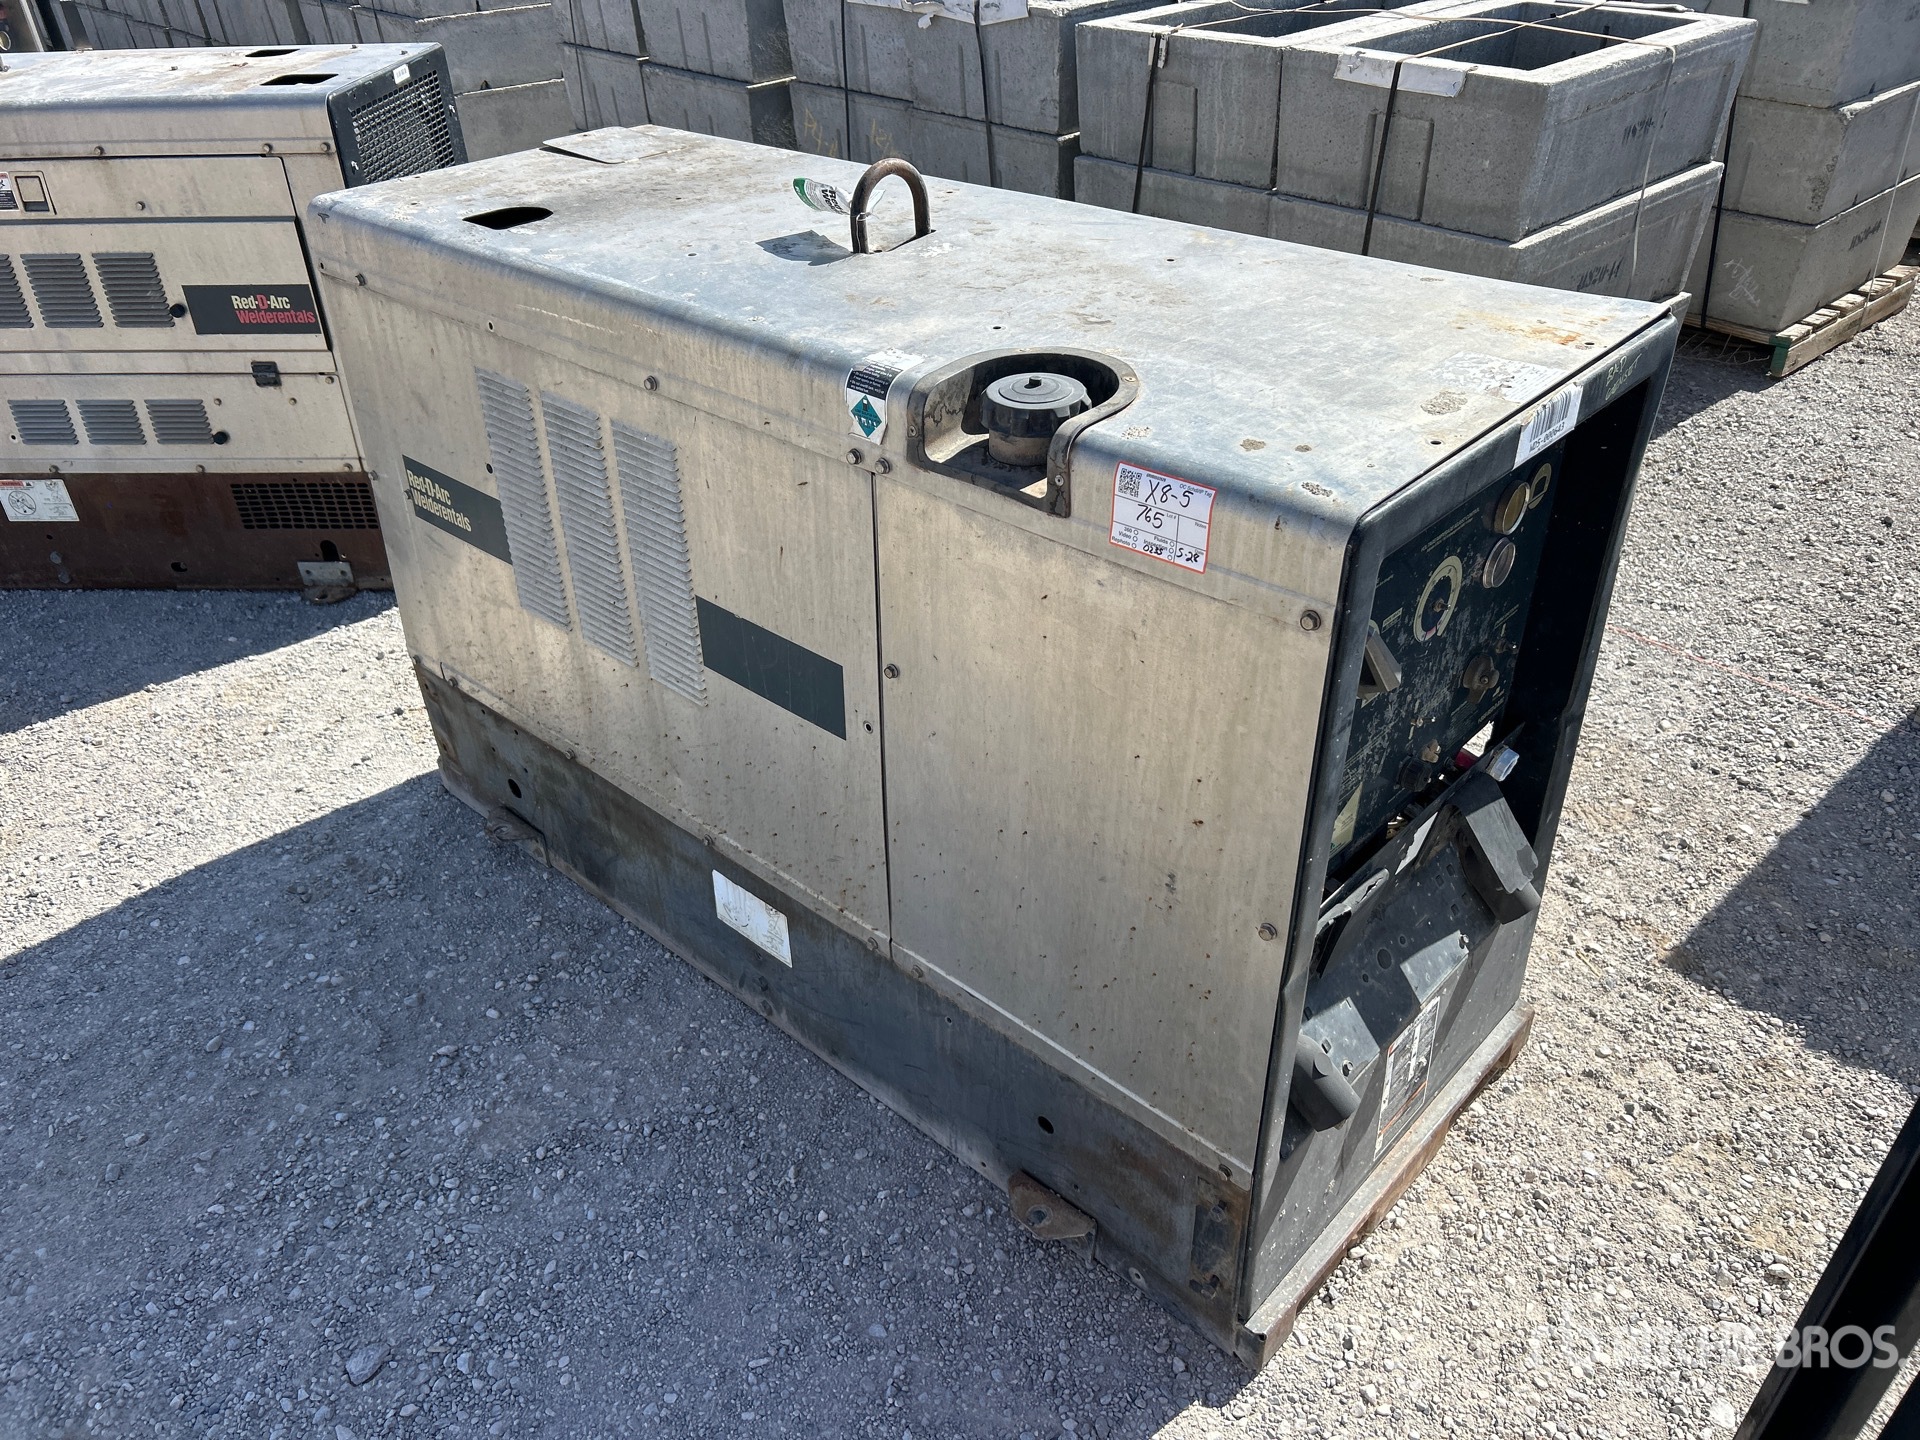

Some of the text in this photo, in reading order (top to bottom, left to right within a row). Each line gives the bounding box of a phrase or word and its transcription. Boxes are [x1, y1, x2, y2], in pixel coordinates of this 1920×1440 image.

[235, 309, 316, 324] Welderentals
[1145, 480, 1194, 508] X8-5
[410, 487, 472, 532] Welderentals
[1136, 504, 1165, 529] 765
[1118, 530, 1132, 539] Video
